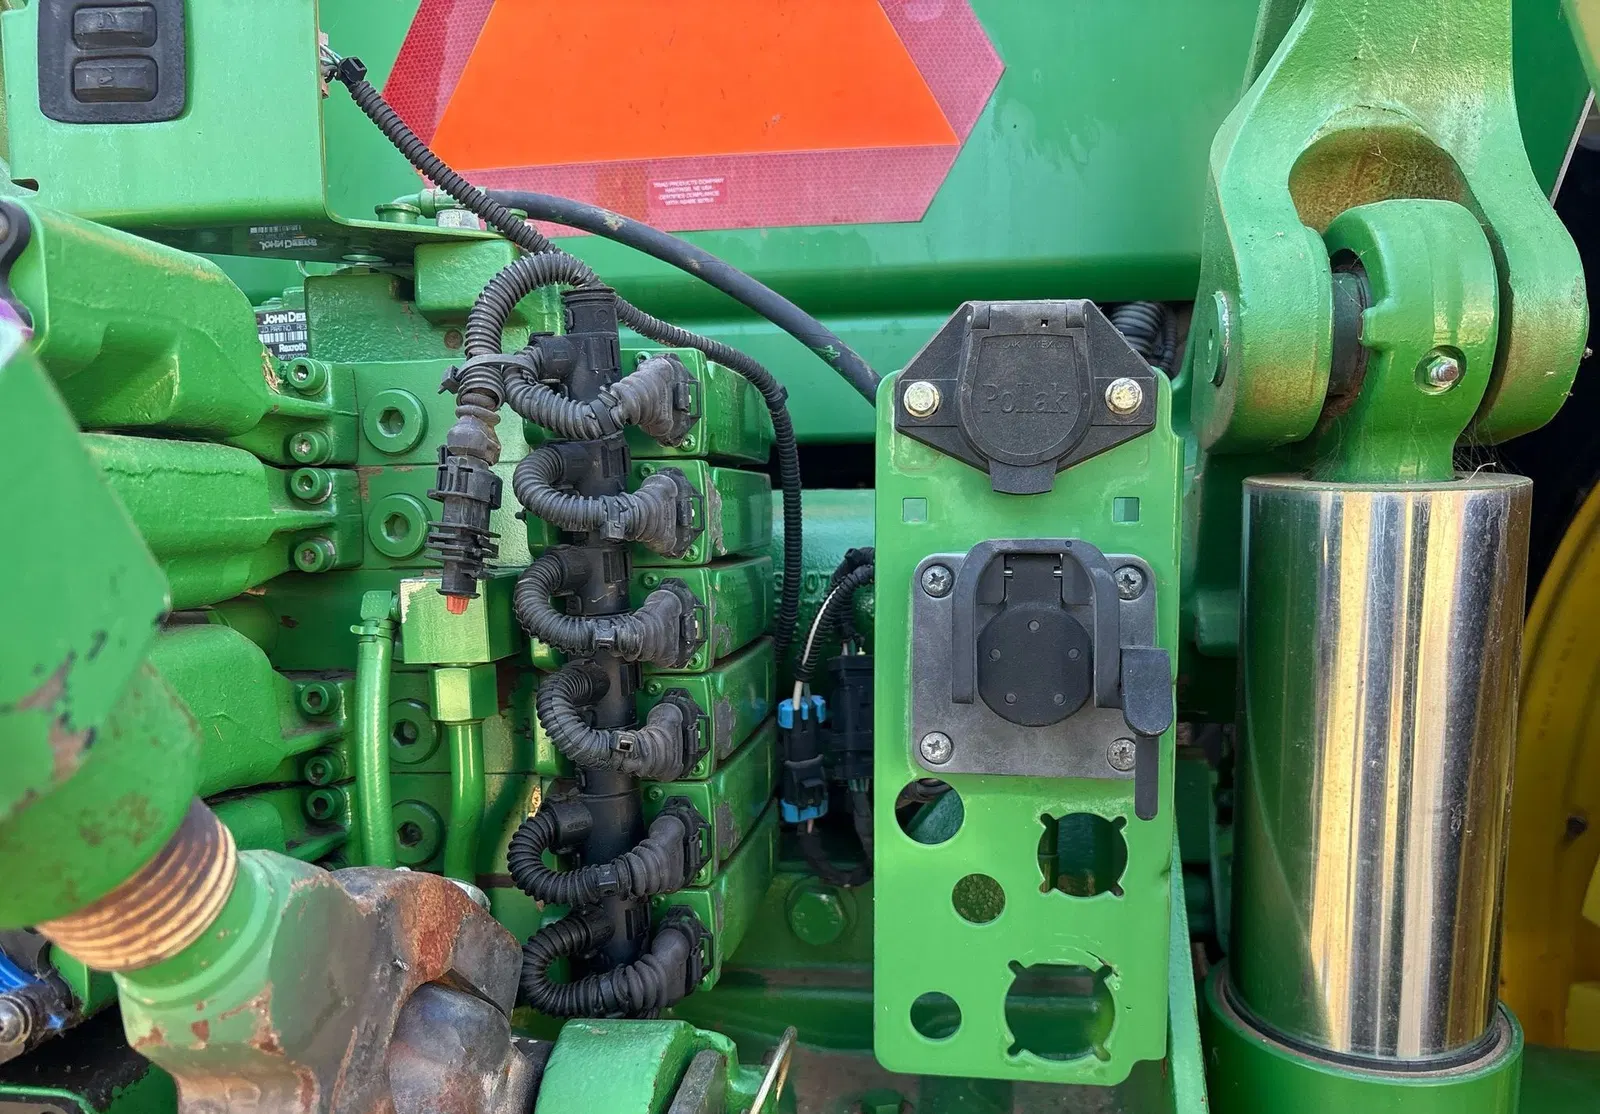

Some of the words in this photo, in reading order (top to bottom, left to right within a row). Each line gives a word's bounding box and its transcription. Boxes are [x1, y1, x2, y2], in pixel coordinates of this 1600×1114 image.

[263, 313, 288, 325] JOHN
[278, 342, 307, 352] Rexroth
[981, 382, 1069, 414] Pollak
